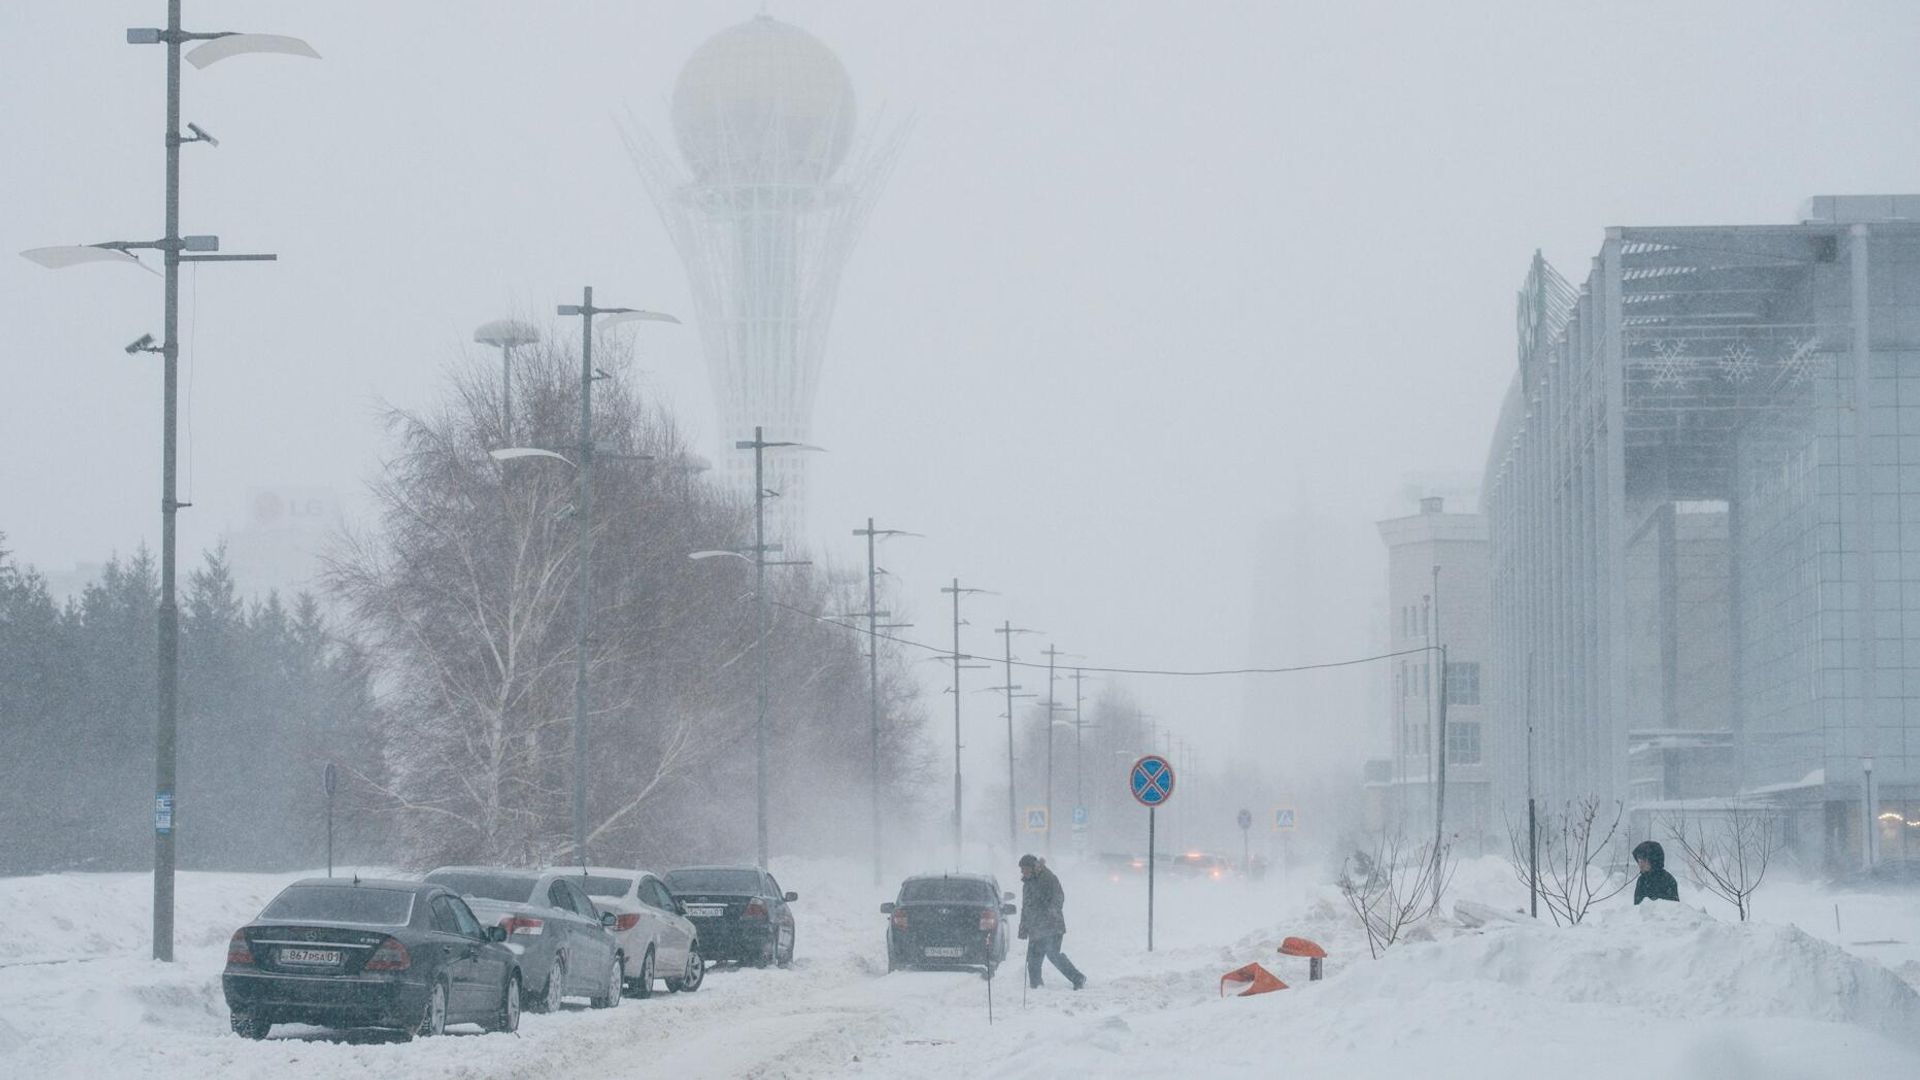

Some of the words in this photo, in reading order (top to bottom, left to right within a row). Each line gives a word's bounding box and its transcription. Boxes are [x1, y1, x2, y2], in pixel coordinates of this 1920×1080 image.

[289, 498, 323, 517] LG
[1074, 808, 1084, 823] P
[327, 952, 339, 962] 01
